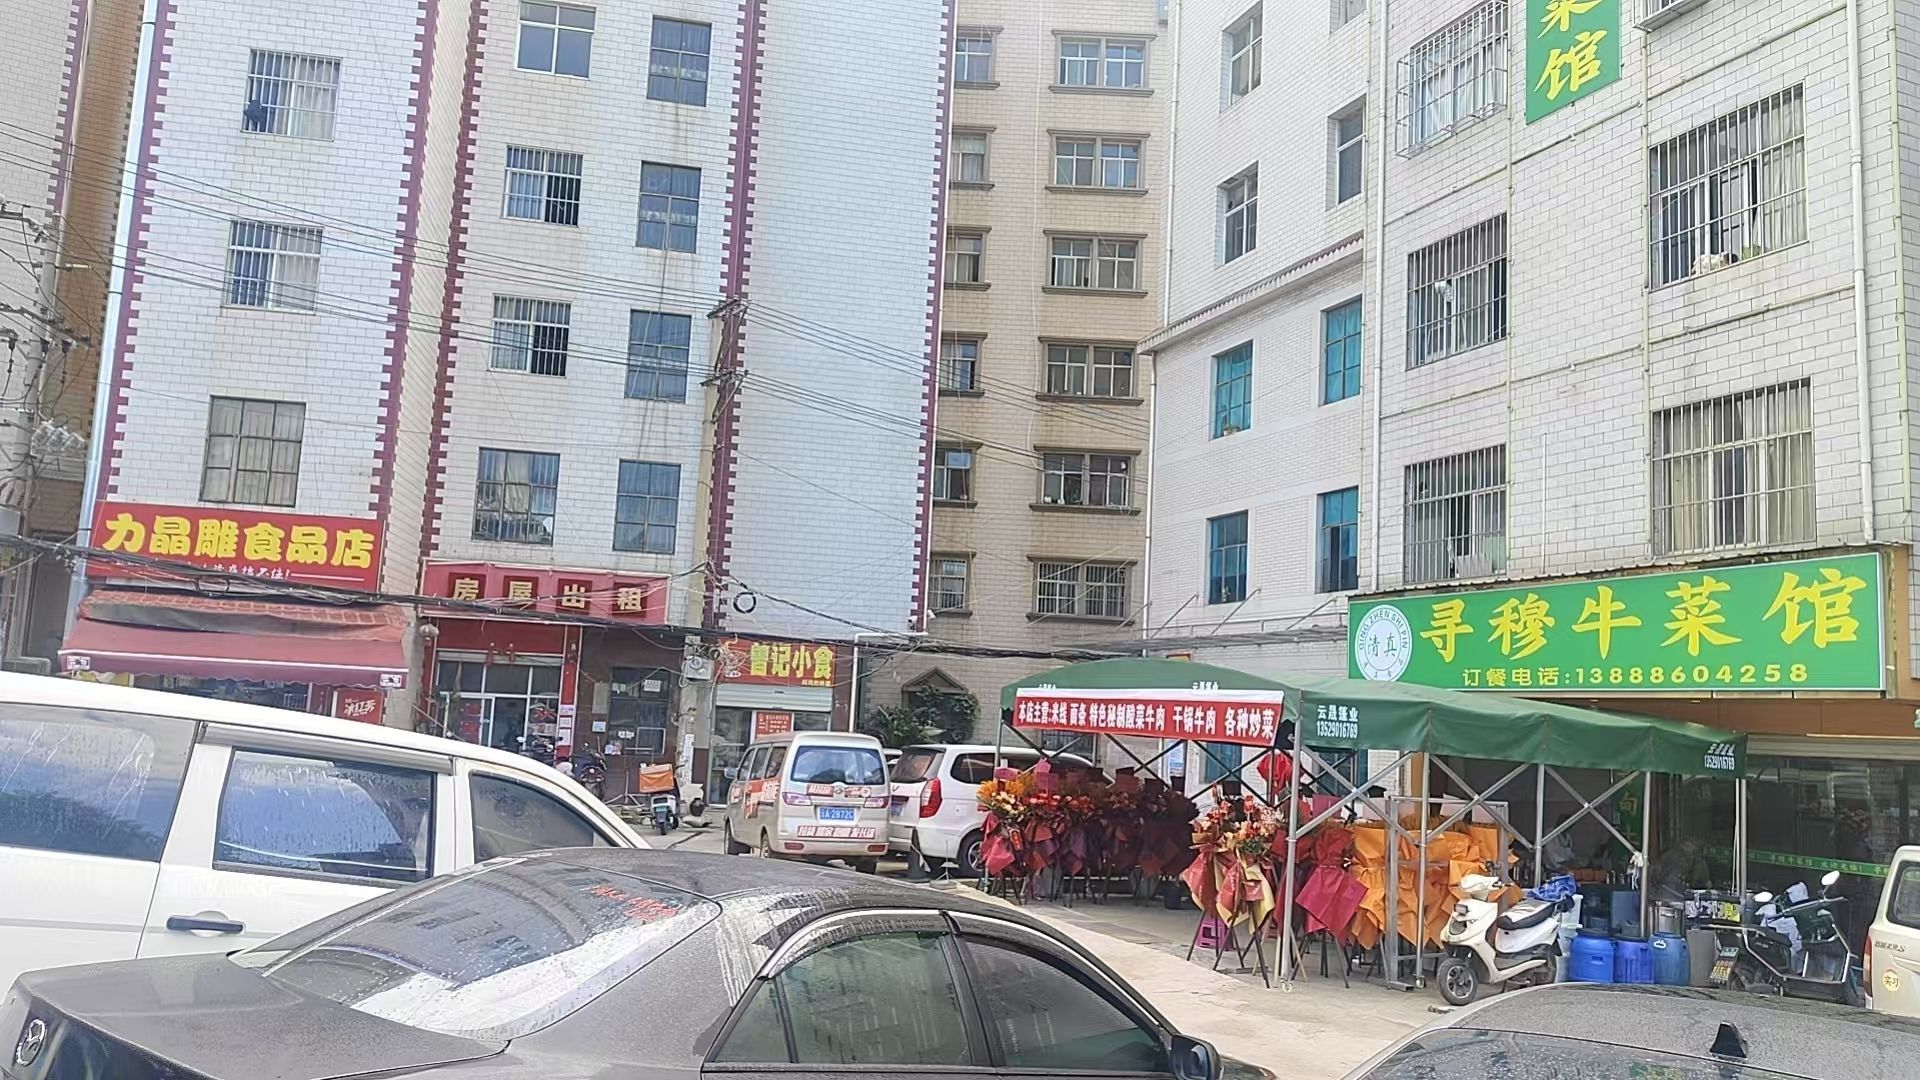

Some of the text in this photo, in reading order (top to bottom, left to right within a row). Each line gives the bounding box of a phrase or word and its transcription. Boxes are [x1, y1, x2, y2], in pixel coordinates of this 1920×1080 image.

[102, 513, 375, 569] 力晶雕食品店
[452, 578, 641, 612] 房屋出租
[1420, 568, 1867, 662] 寻穆牛菜馆
[1368, 632, 1397, 657] 清真
[1069, 702, 1088, 727] 面条
[1172, 704, 1217, 736] 干锅牛肉
[1224, 706, 1275, 740] 各种炒菜
